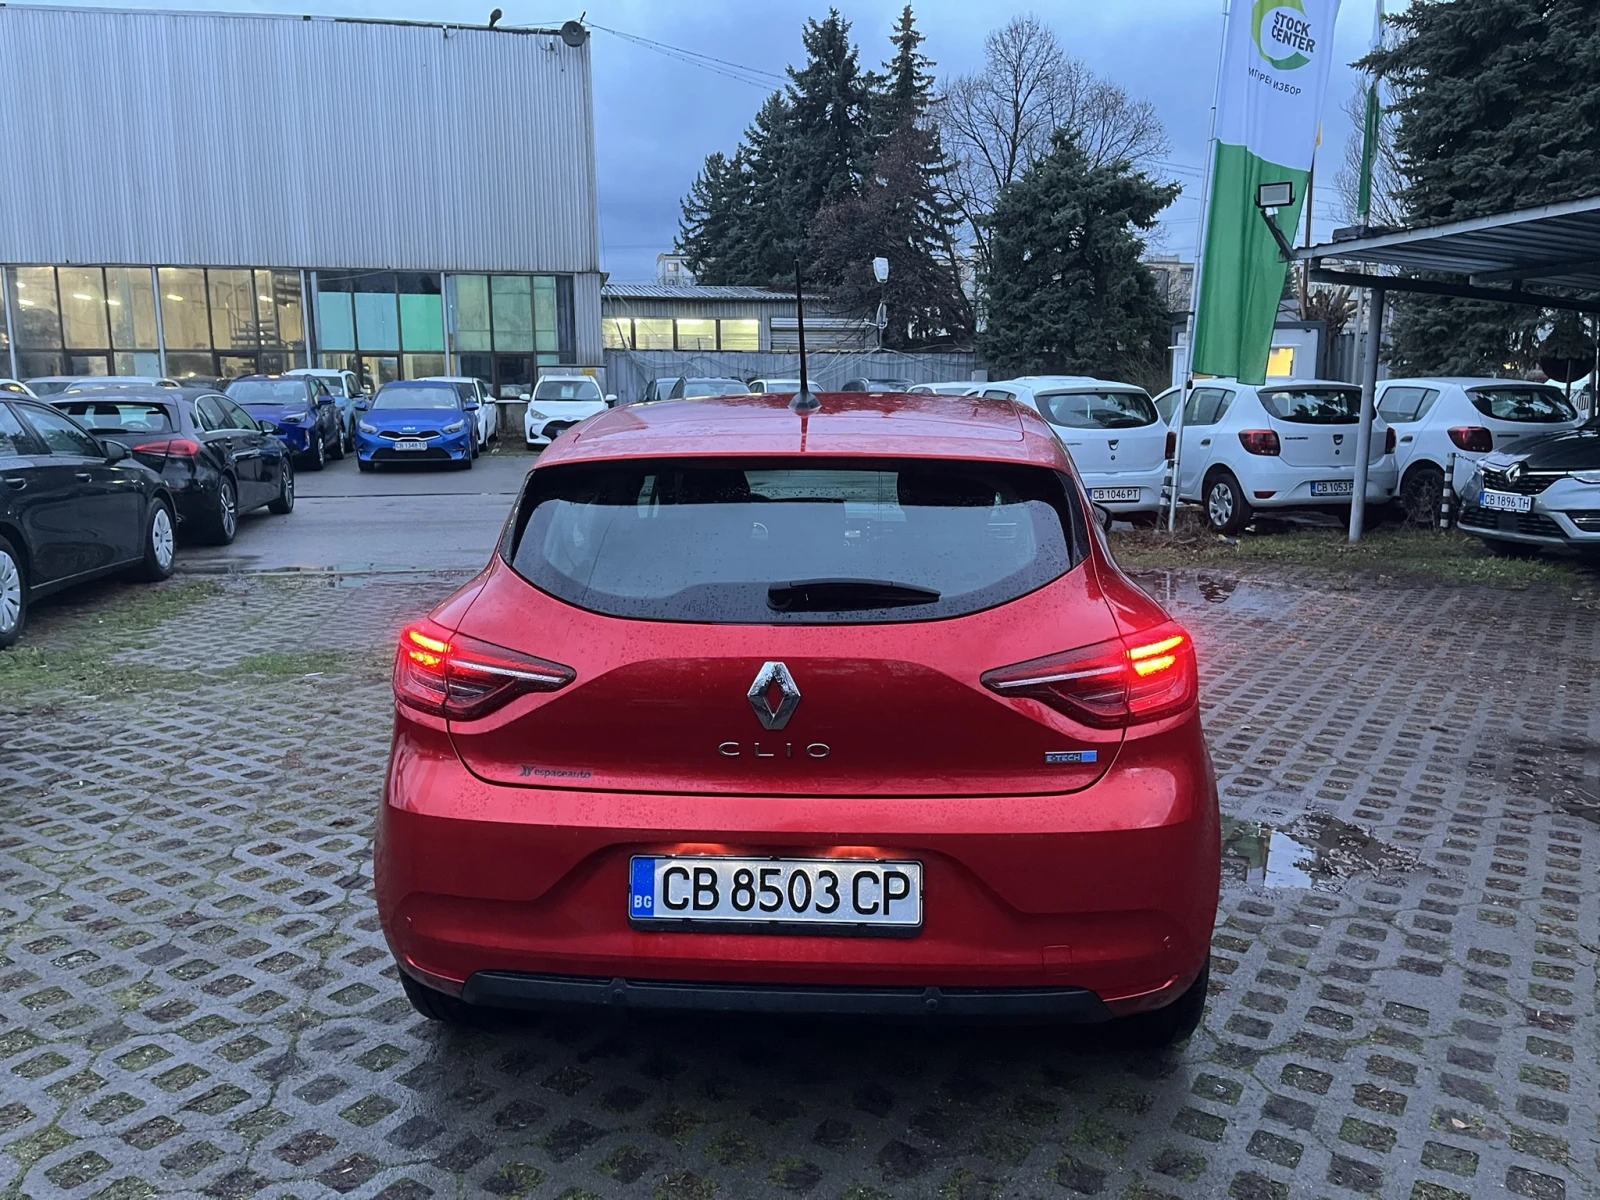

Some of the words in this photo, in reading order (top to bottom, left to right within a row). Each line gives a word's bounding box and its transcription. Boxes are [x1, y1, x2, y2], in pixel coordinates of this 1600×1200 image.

[1274, 11, 1311, 37] STOCK
[1271, 25, 1316, 53] CENTER
[1273, 80, 1301, 96] ИЗБОР
[1093, 490, 1104, 499] CB
[1106, 490, 1126, 499] 1046
[1127, 490, 1138, 498] PT
[1317, 483, 1327, 492] CB
[1330, 483, 1348, 492] 1053
[1485, 494, 1495, 505] CB
[1497, 496, 1516, 507] 1896
[1518, 498, 1530, 509] TH
[719, 741, 830, 757] CLIO
[1046, 754, 1081, 762] E-TECH
[534, 768, 592, 779] espaceauto
[663, 866, 720, 911] CB
[731, 868, 841, 914] 8503
[852, 870, 911, 916] CP
[634, 895, 652, 909] BG
